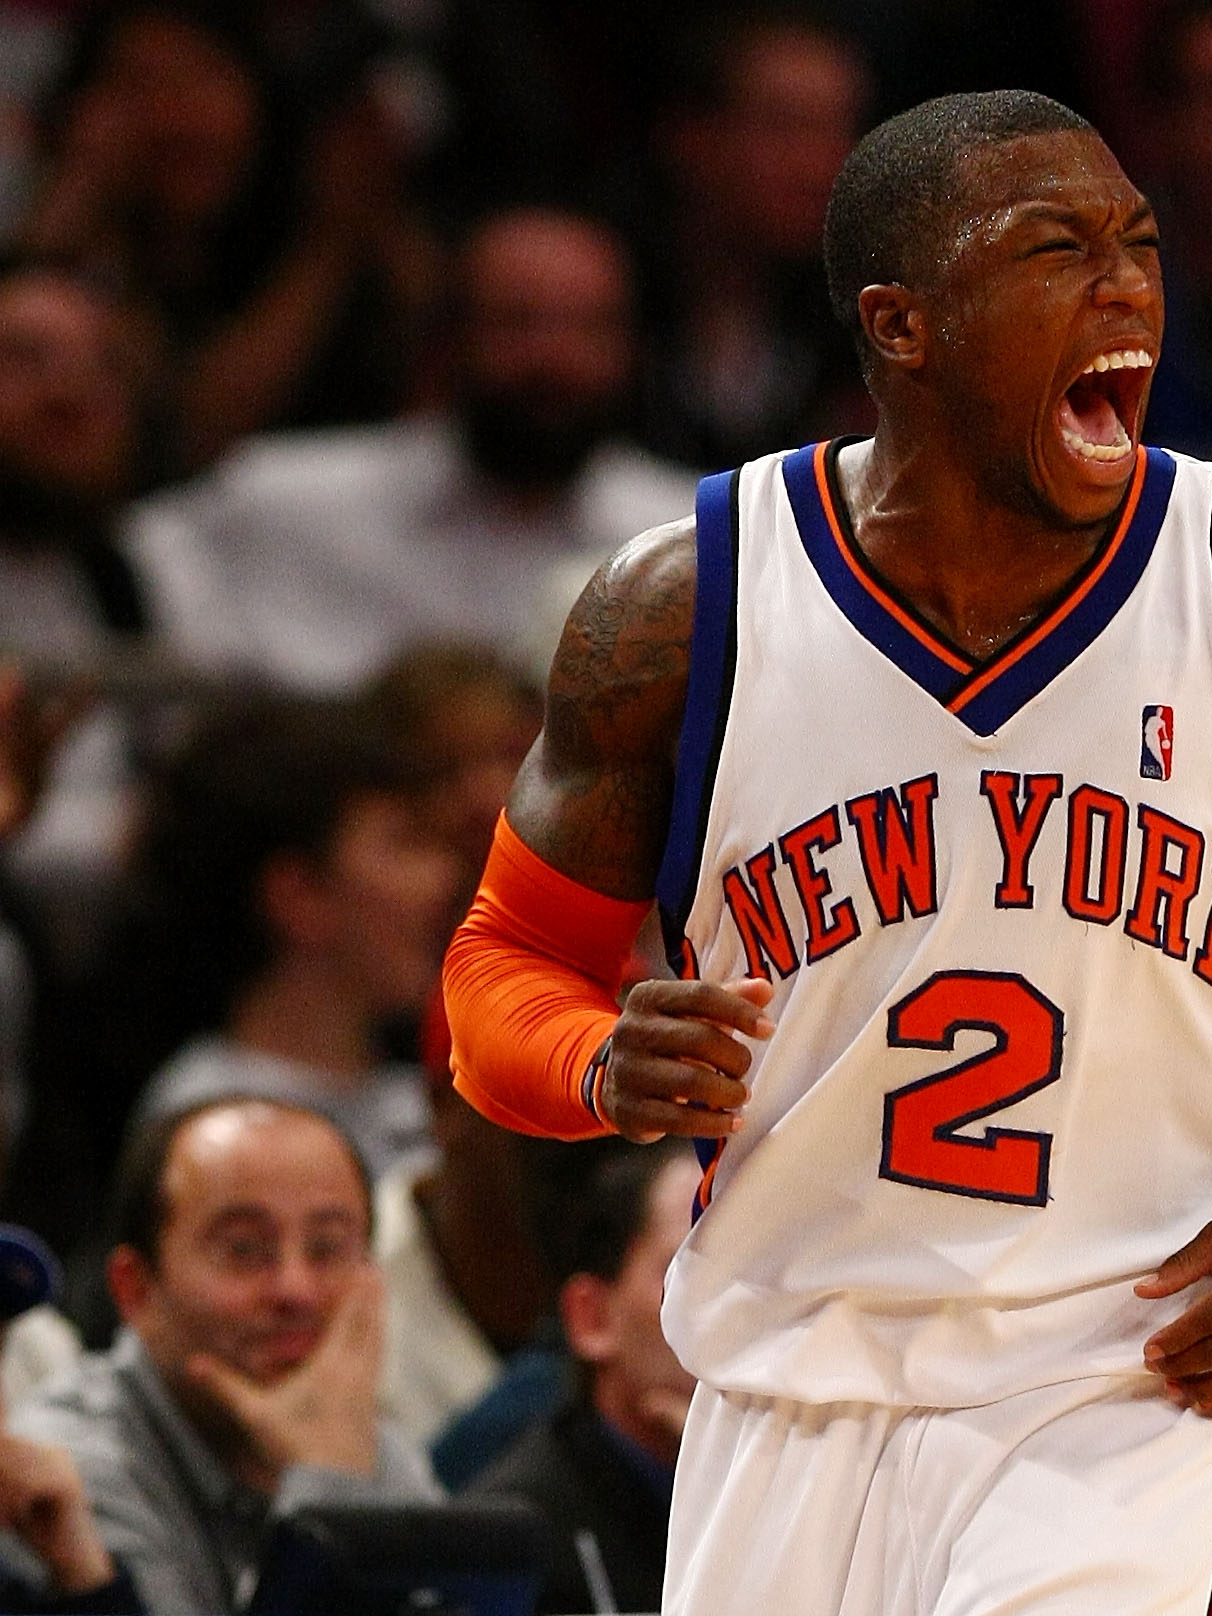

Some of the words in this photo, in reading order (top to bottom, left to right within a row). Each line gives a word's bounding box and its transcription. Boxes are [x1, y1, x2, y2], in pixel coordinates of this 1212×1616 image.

[1143, 765, 1161, 777] NBA
[722, 772, 939, 982] NEW
[879, 969, 1065, 1208] 2
